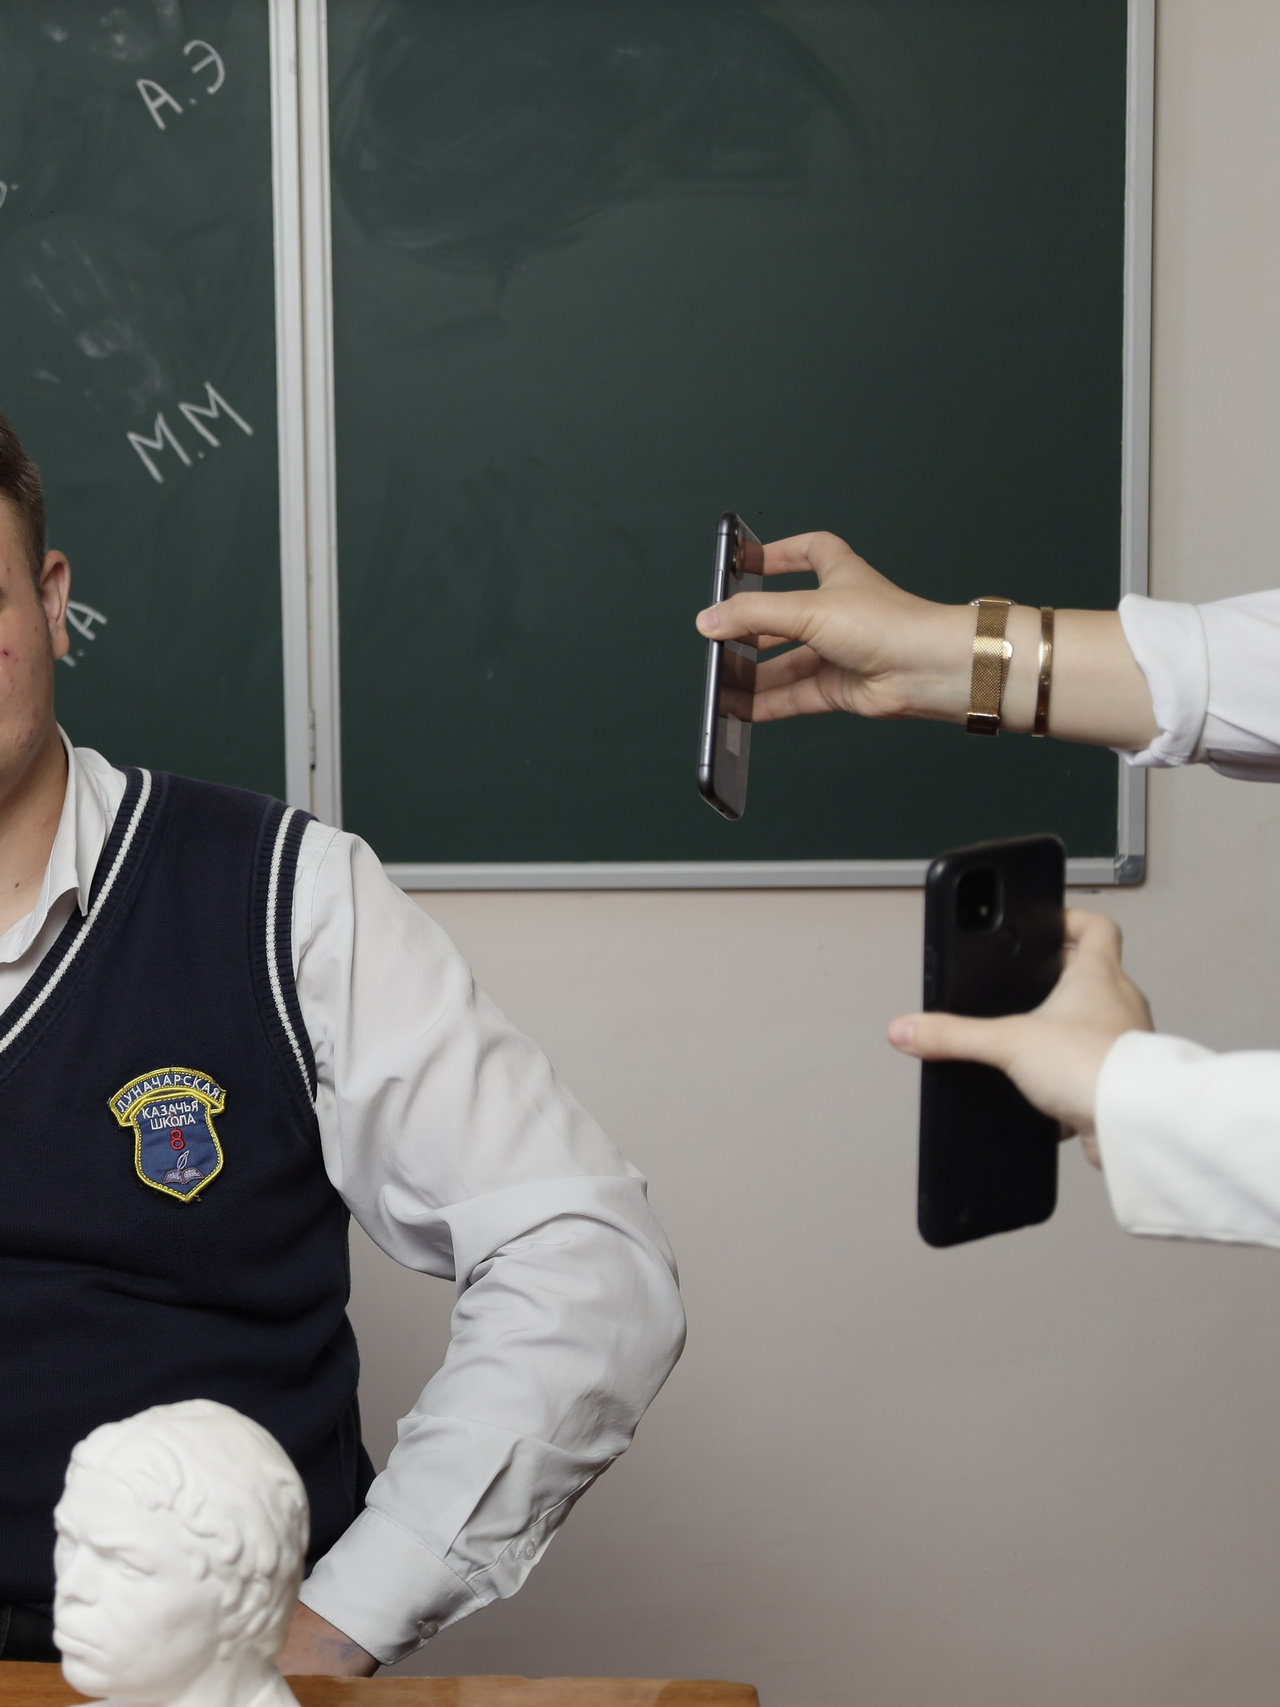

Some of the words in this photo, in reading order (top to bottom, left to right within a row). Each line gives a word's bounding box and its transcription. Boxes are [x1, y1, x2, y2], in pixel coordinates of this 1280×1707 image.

[136, 40, 226, 130] А.Э
[115, 1074, 220, 1113] ЛУНАЧАРСКАЯ
[142, 1099, 199, 1119] КАЗАЧЬЯ
[150, 1114, 196, 1130] ШКОЛА
[170, 1129, 186, 1150] 8
